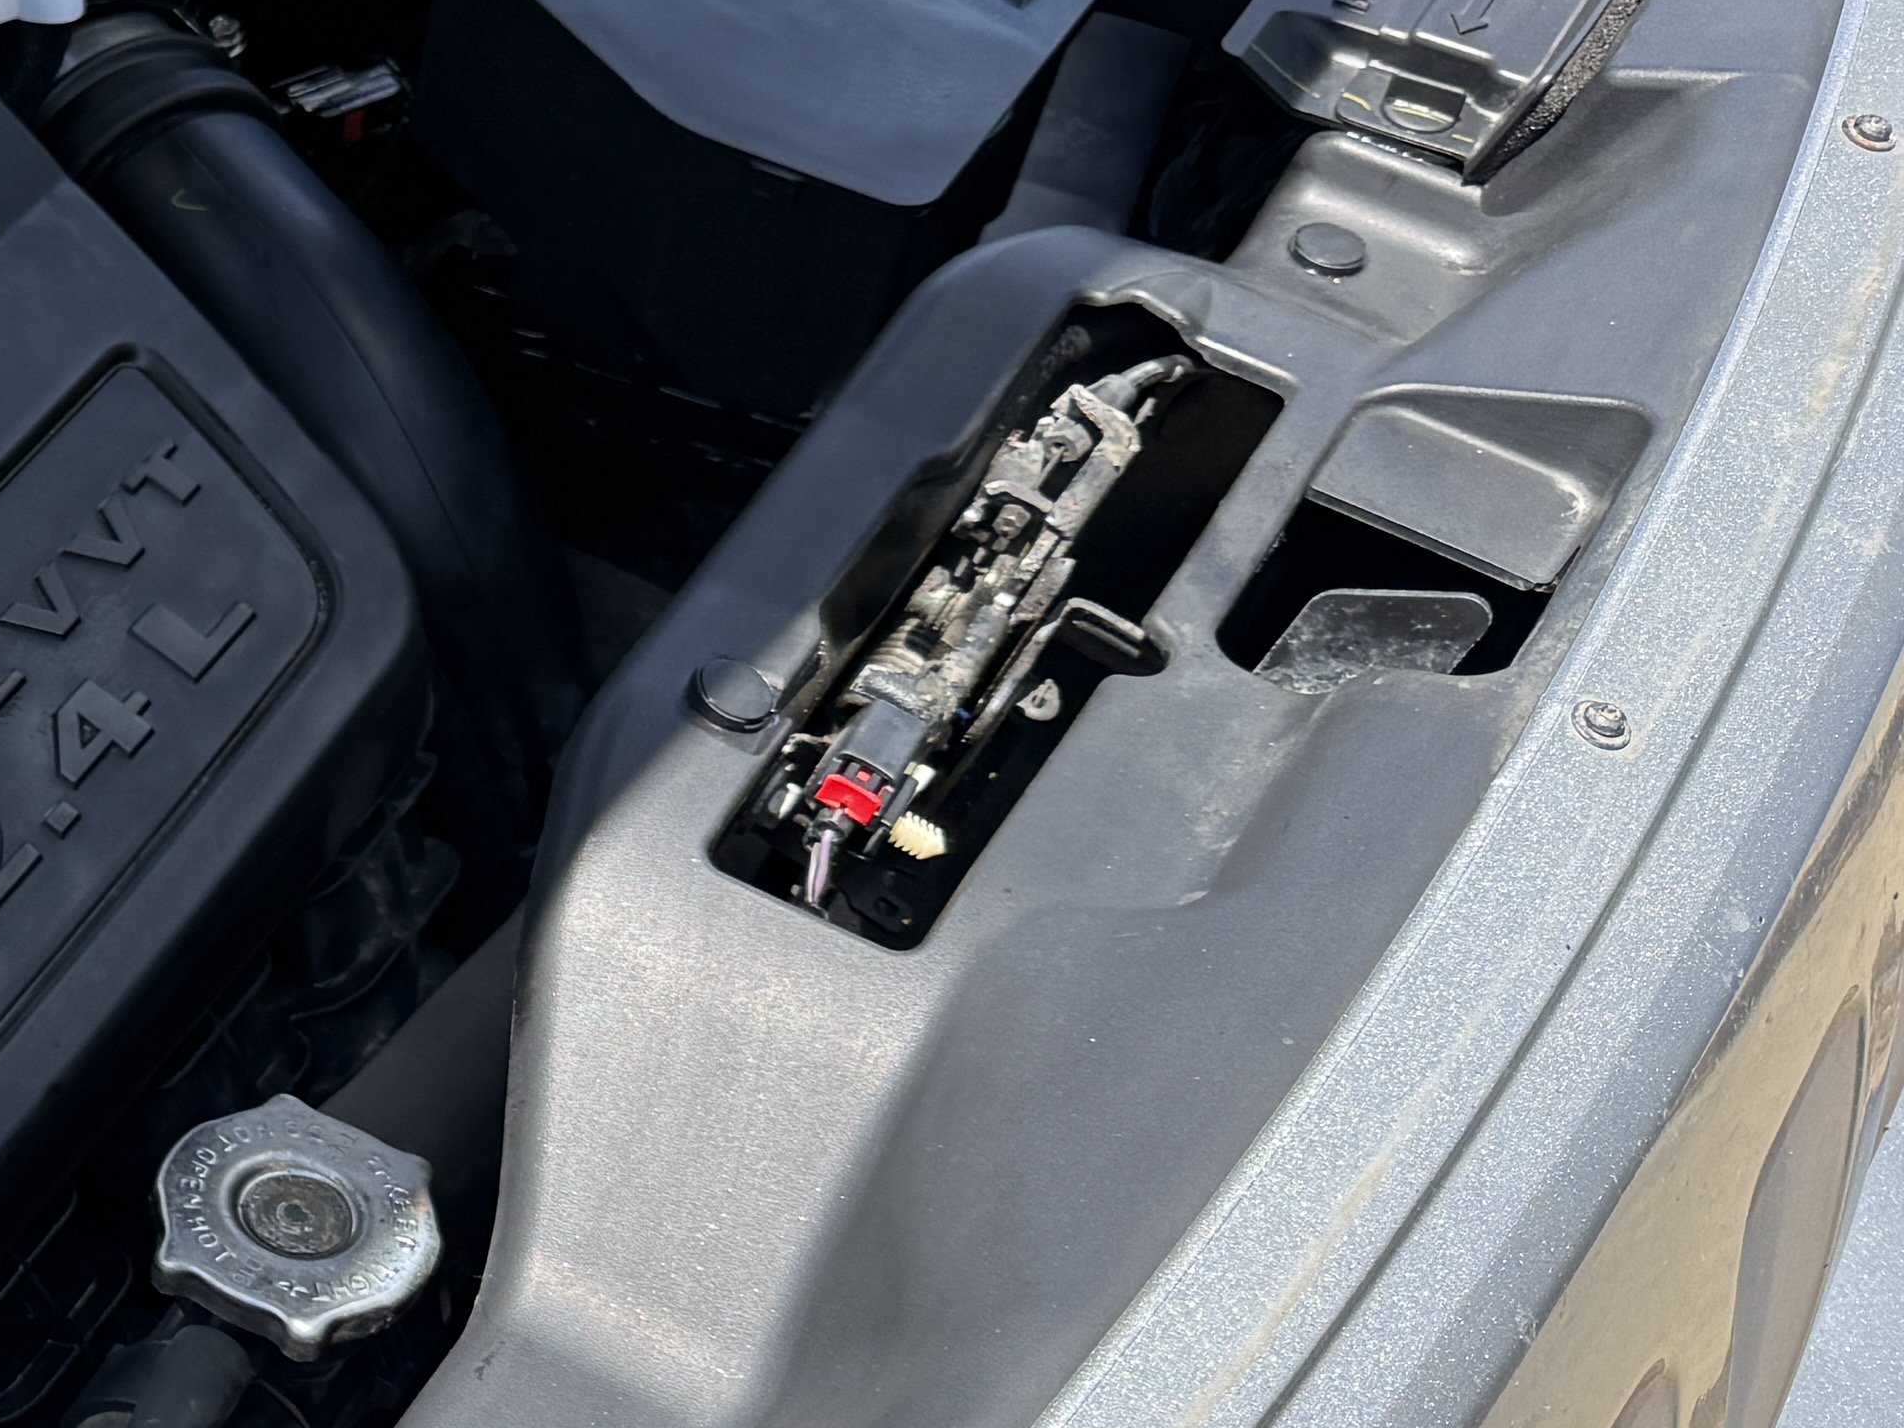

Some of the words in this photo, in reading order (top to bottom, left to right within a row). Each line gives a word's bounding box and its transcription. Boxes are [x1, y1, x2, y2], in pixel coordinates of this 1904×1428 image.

[0, 440, 203, 640] VVT
[180, 1146, 217, 1210] OPEN
[187, 1217, 238, 1263] HOT
